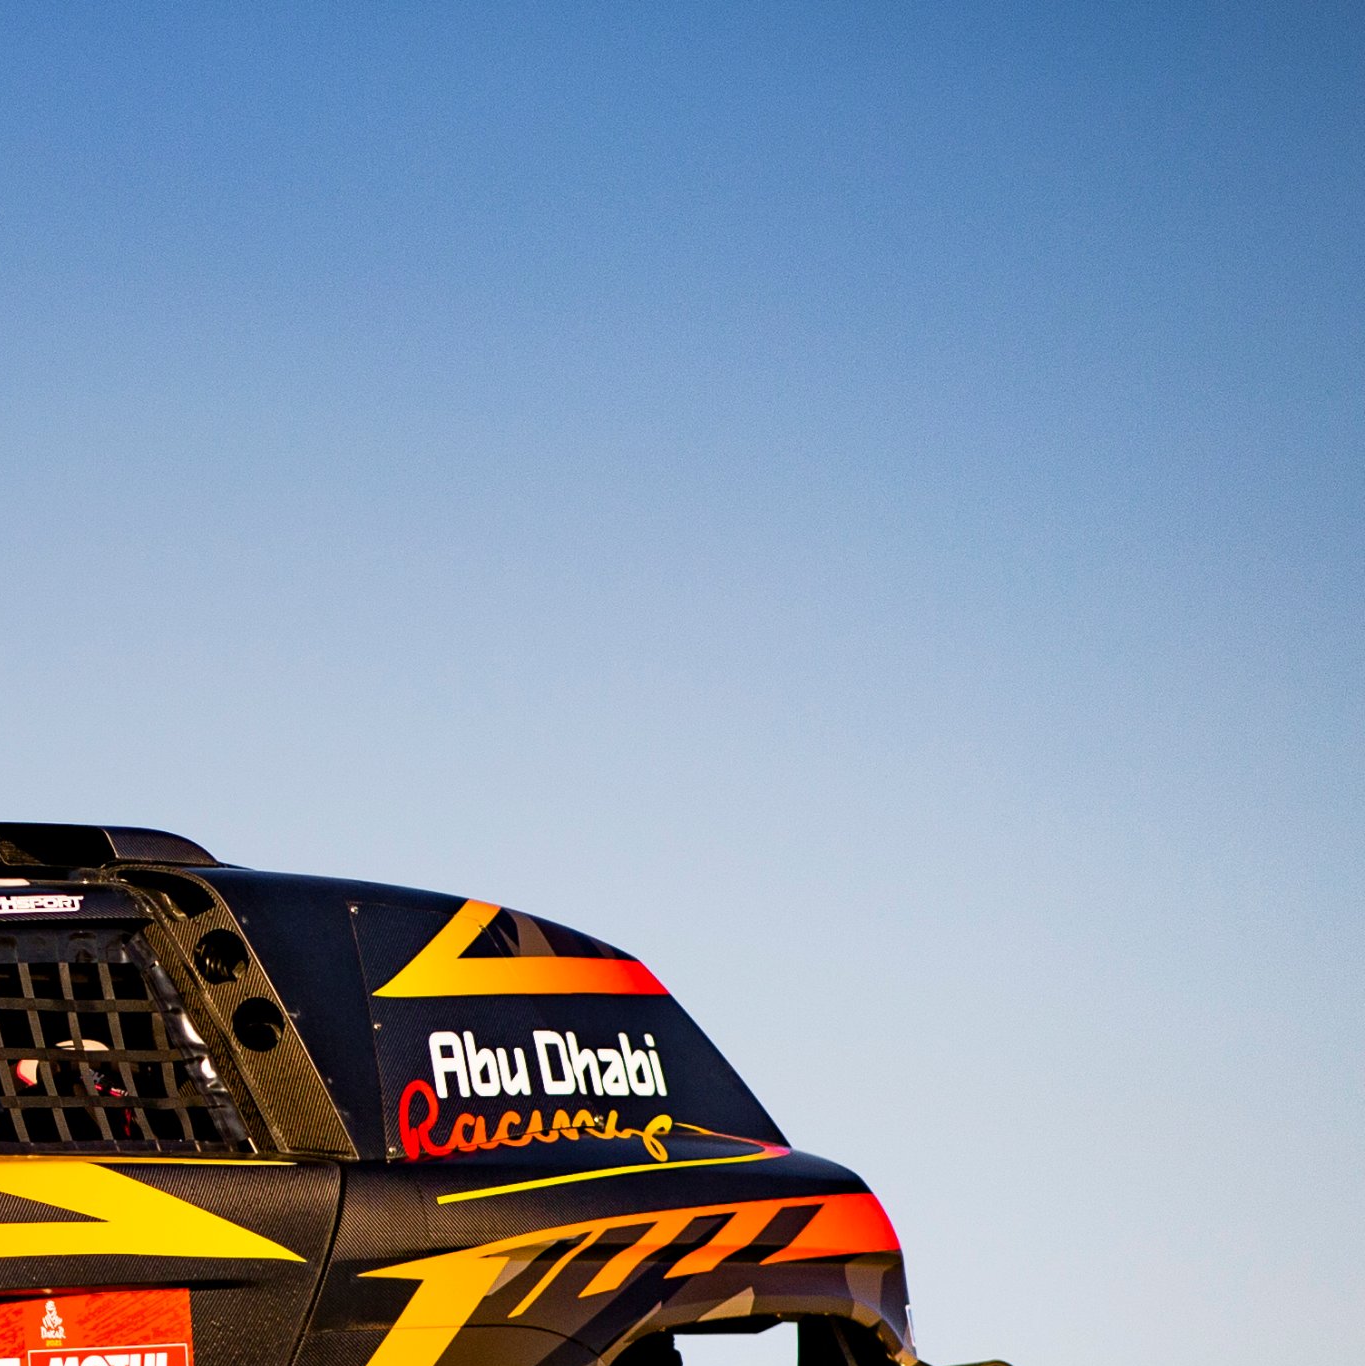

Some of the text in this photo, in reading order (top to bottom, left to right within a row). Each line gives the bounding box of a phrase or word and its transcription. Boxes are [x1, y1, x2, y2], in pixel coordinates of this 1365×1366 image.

[428, 1030, 668, 1099] Abu Dhabi
[399, 1079, 673, 1163] Racing
